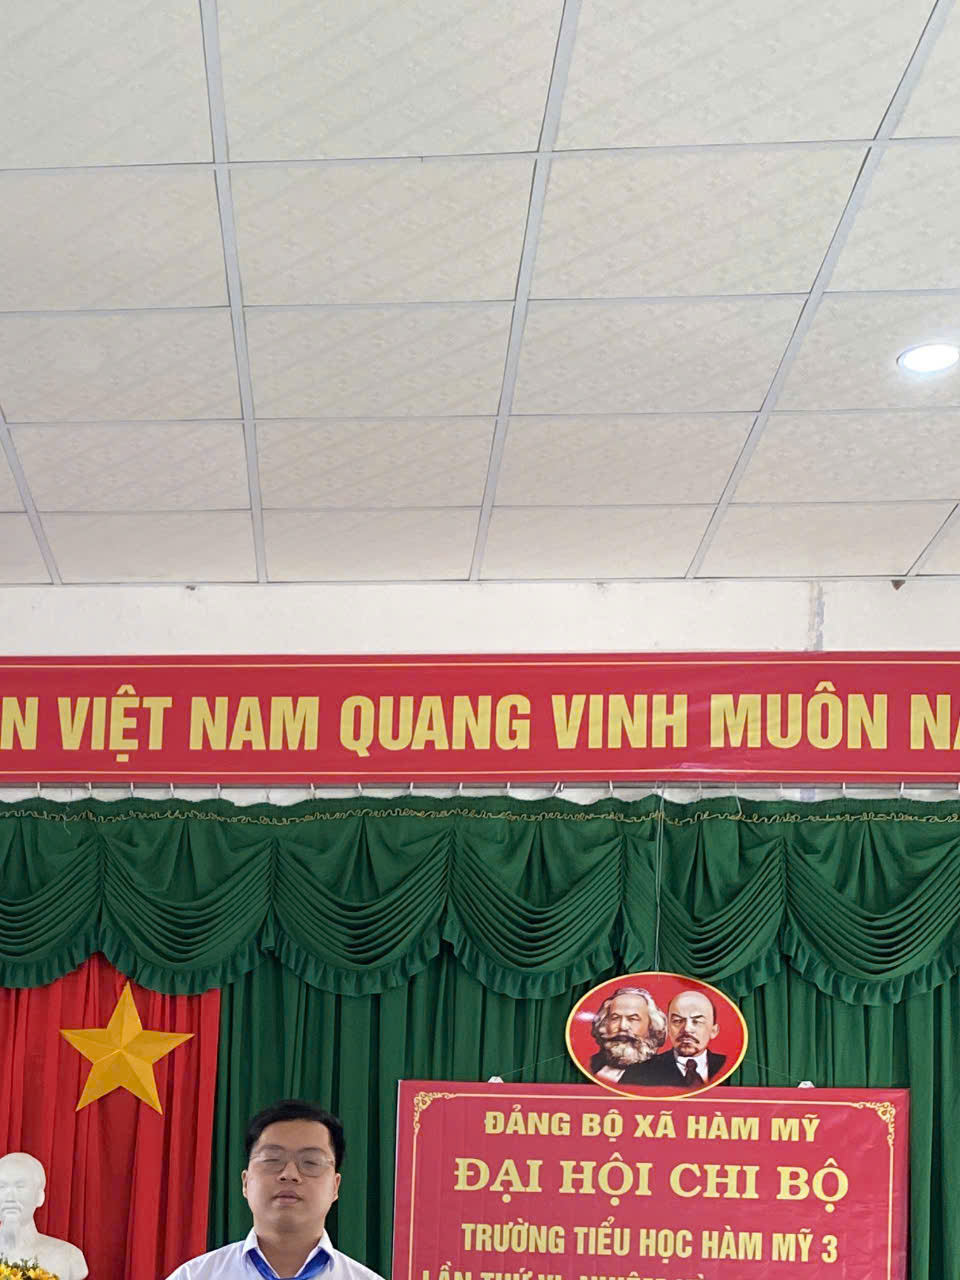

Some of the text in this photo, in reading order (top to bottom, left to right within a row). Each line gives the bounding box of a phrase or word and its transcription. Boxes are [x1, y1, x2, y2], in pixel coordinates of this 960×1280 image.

[57, 684, 172, 762] VIỆT
[189, 695, 319, 751] NAM
[340, 694, 531, 758] QUANG
[551, 694, 688, 749] VINH
[709, 680, 888, 750] MUÔN
[910, 693, 960, 751] N
[484, 1105, 821, 1143] ĐẢNG BỘ XÃ HÀM MỸ
[454, 1152, 850, 1213] ĐẠI HỘI CHI BỘ
[462, 1217, 838, 1263] TRƯỜNG TIỂU HỌC HÀM MỸ 3
